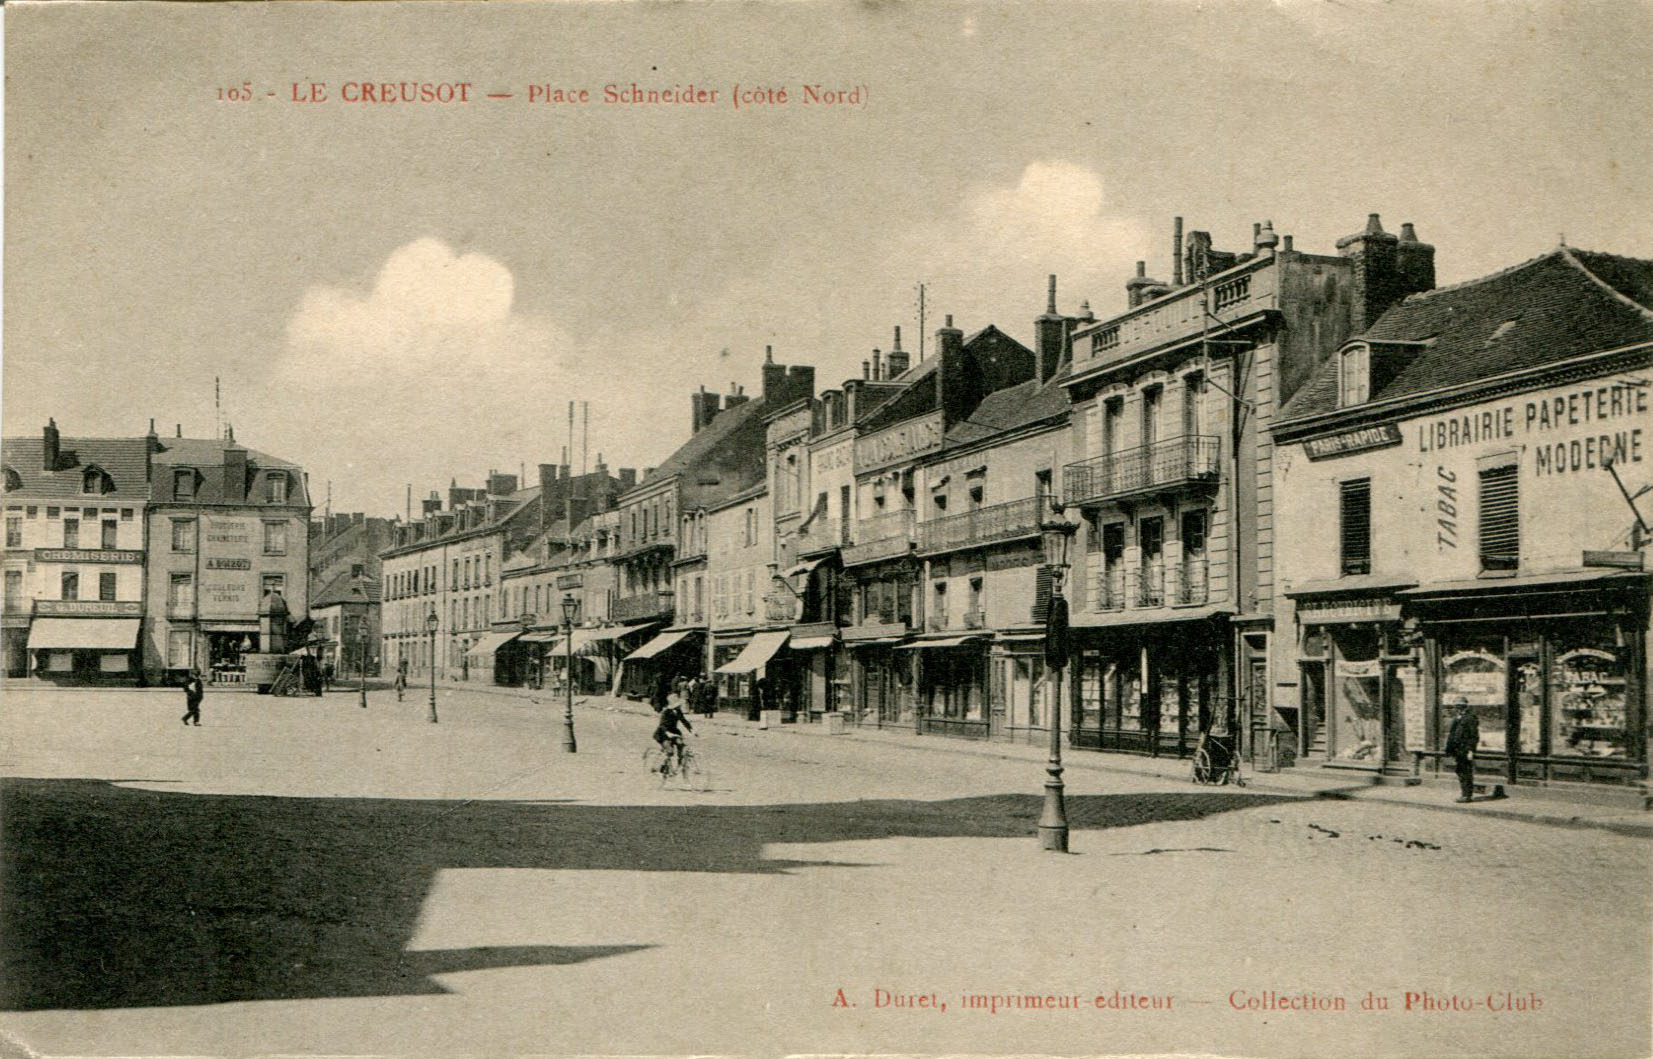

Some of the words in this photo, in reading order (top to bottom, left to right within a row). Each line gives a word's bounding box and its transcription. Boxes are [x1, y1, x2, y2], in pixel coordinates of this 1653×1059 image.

[1419, 406, 1514, 453] LIBRAIRIE
[1525, 384, 1650, 433] PAPETERIE
[1437, 465, 1458, 549] TABAC
[42, 549, 136, 562] CHEMISERIE
